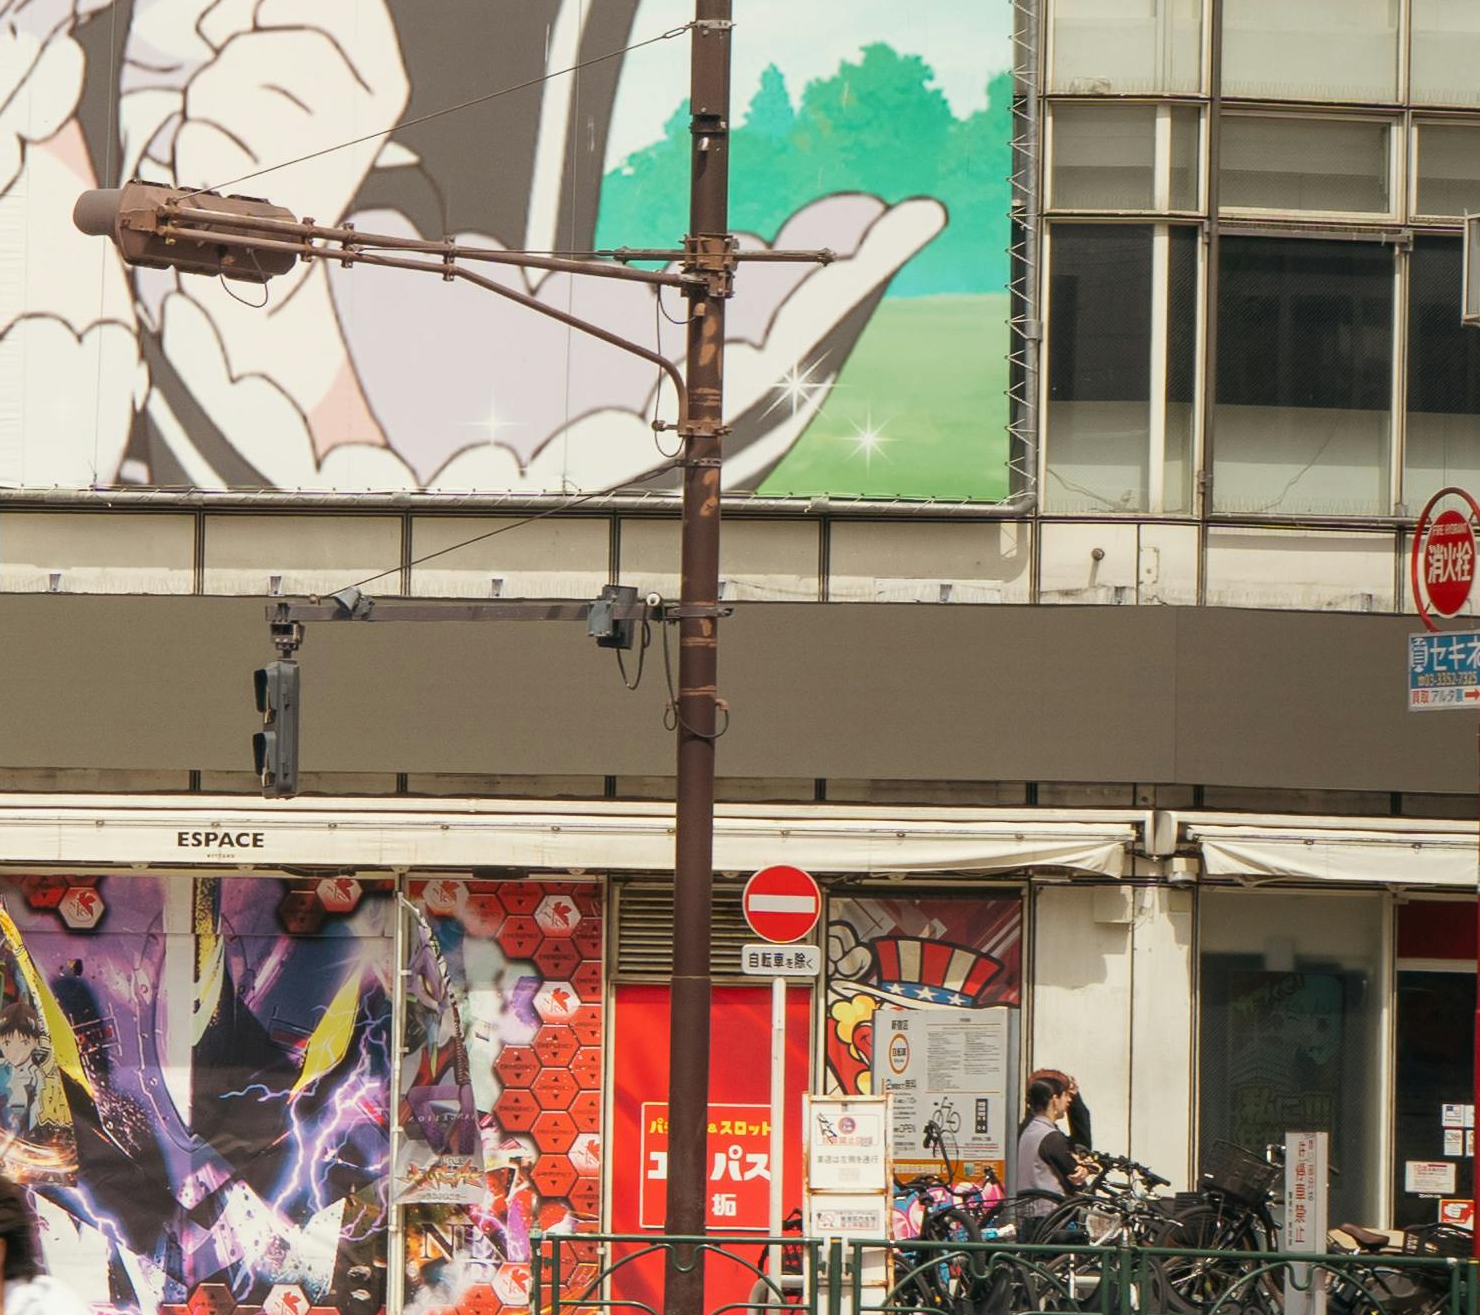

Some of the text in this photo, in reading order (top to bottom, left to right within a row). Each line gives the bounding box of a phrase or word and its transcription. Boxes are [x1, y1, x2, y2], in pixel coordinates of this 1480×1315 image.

[1427, 541, 1472, 584] 消火栓
[177, 831, 265, 848] ESPACE
[747, 949, 816, 971] 自転車を除く
[646, 1145, 772, 1182] エパス
